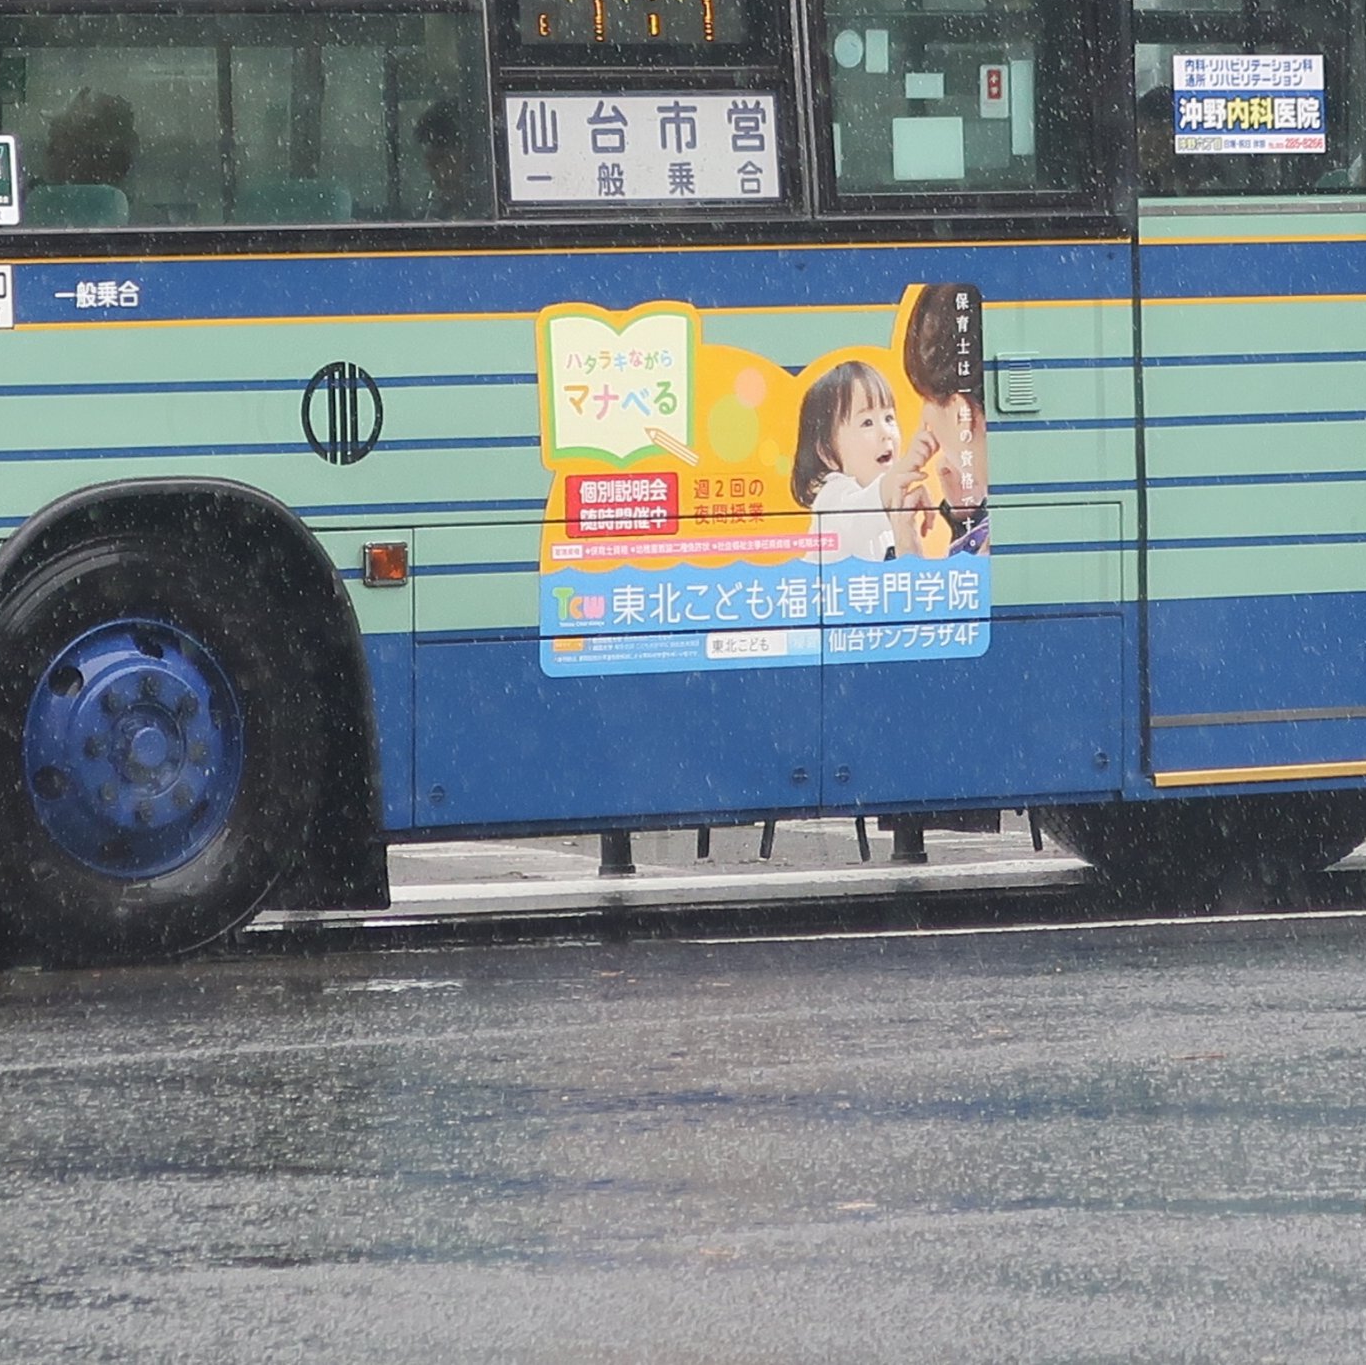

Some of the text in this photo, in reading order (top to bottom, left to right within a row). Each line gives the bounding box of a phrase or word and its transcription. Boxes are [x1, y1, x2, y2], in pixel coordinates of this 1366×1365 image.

[1209, 73, 1303, 87] リハビリテーション
[1179, 96, 1321, 131] 沖野内科医院
[516, 99, 768, 158] 仙台市営
[526, 160, 764, 199] 一般乗合
[54, 280, 141, 309] 一般乗合
[565, 349, 674, 375] ハタラキながら
[579, 478, 668, 504] 個別説明会
[579, 505, 668, 532] 随時開催中
[693, 501, 765, 526] 夜間授業
[611, 569, 980, 625] 東北こども福祉専門学院
[711, 637, 771, 654] 東北こども
[828, 623, 980, 653] 仙台サンプラザ4F
